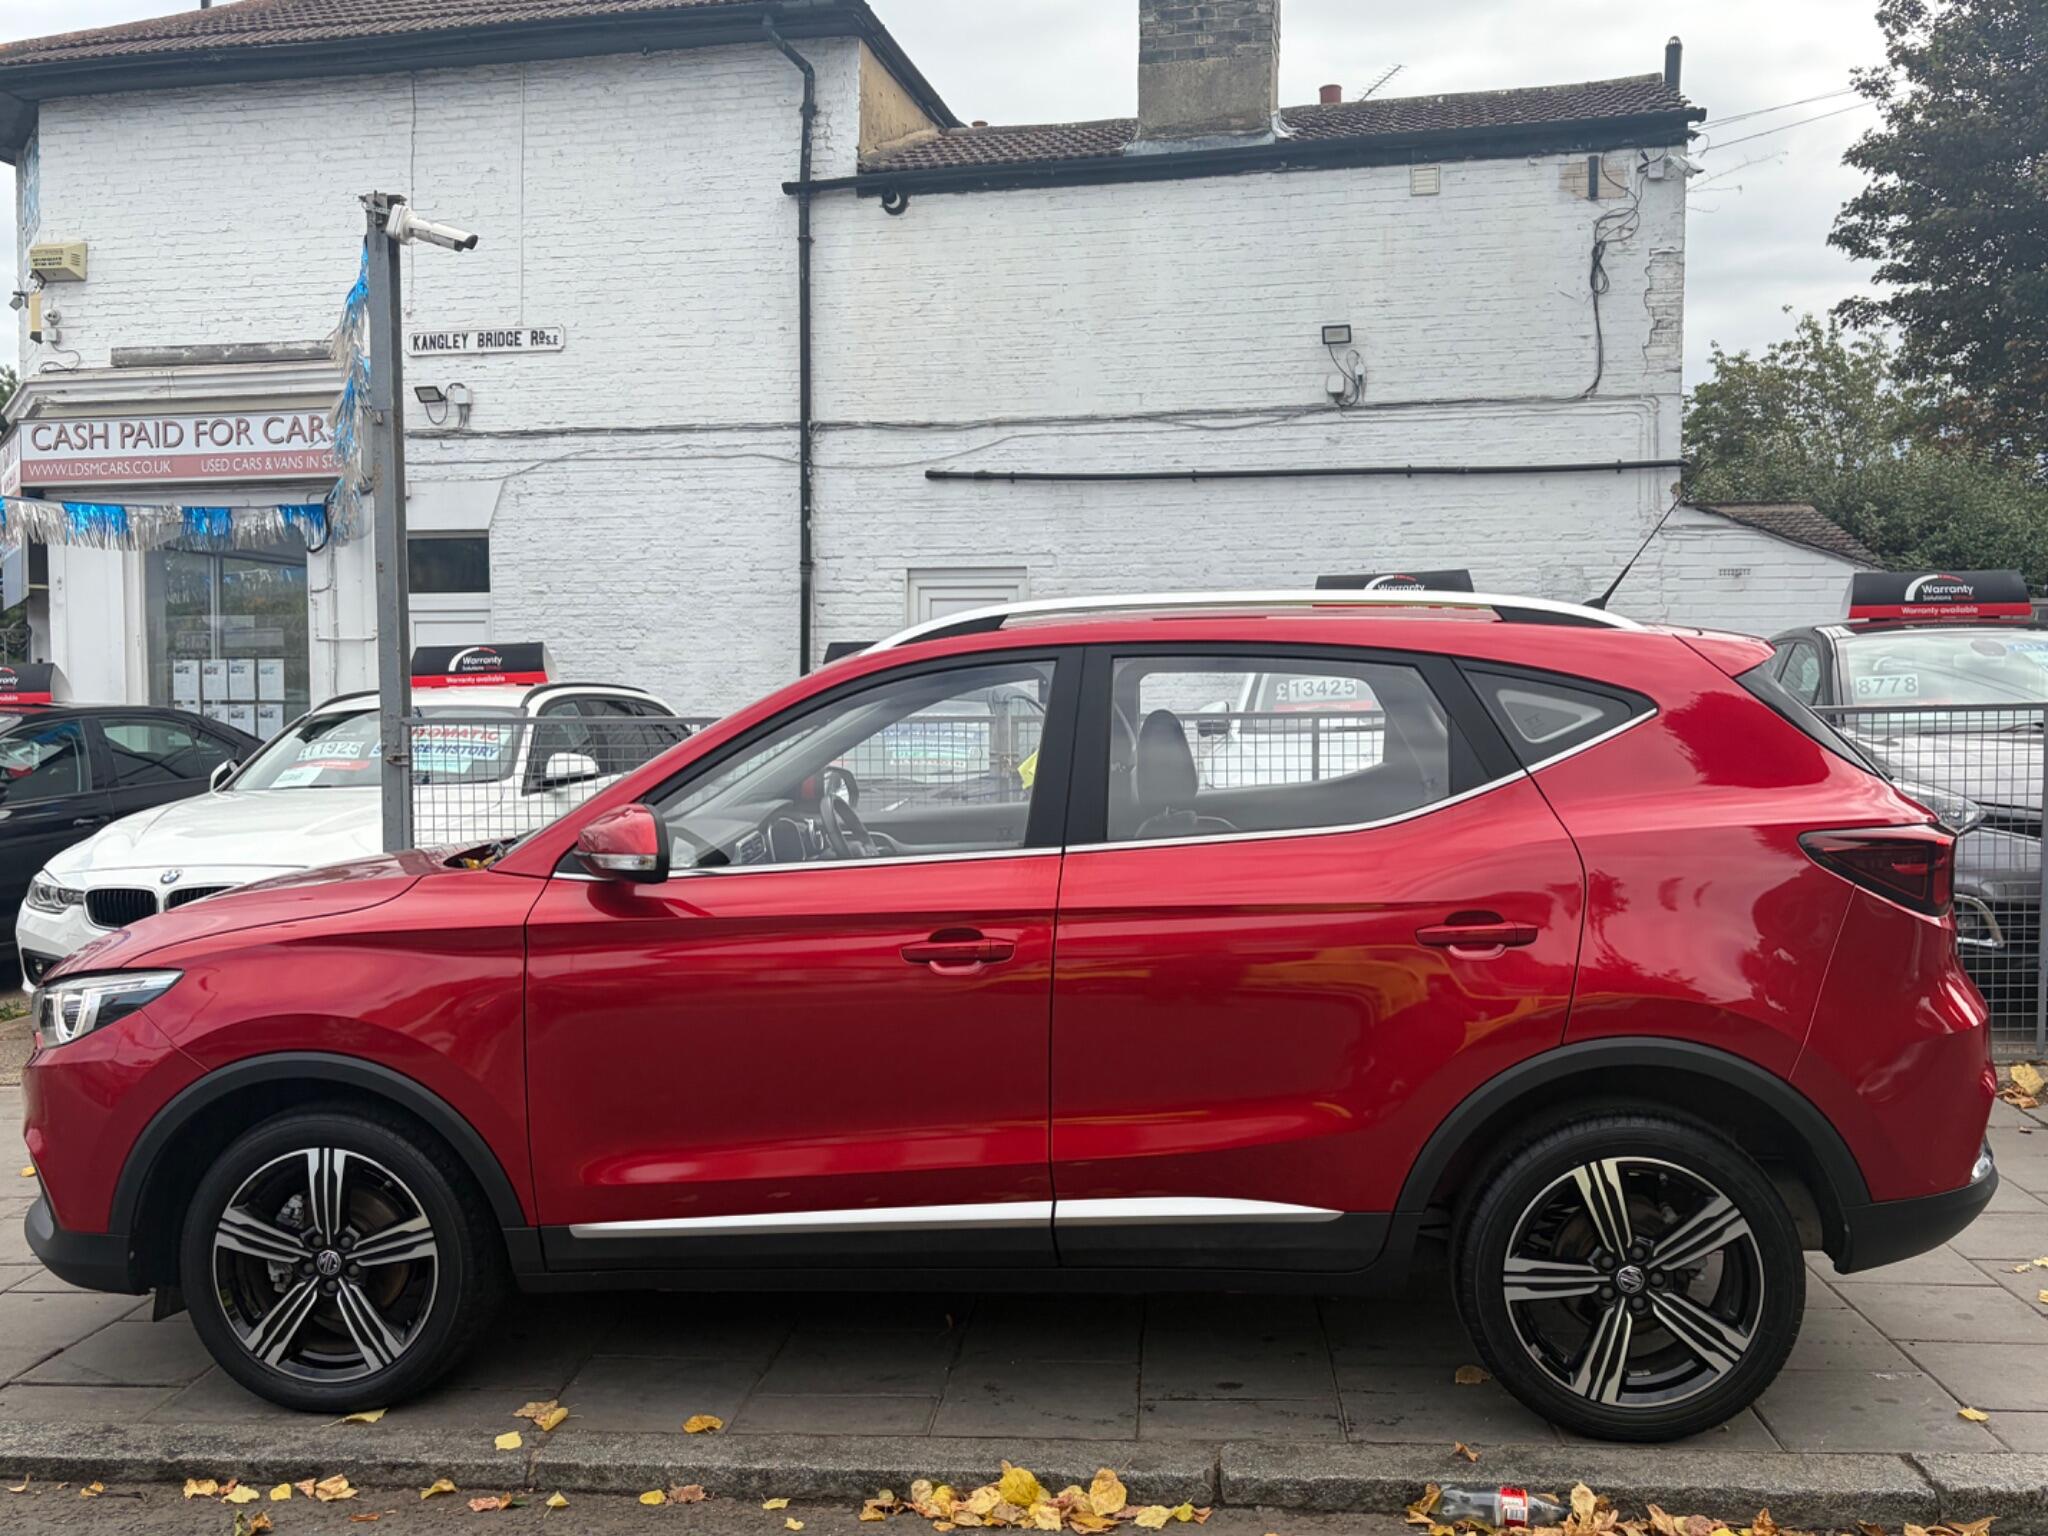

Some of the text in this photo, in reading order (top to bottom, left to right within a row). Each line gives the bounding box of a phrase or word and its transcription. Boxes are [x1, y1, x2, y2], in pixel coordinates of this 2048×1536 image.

[413, 332, 468, 350] KANGLEY
[477, 331, 522, 348] BRIDGE
[31, 422, 109, 450] CASH
[119, 420, 184, 449] PAID
[194, 416, 253, 447] FOR
[28, 460, 172, 476] WWW.LDSMCARS.CO.UK
[201, 458, 230, 472] USED
[233, 457, 262, 471] CARS
[265, 457, 273, 470] &
[274, 455, 303, 469] VANS
[306, 455, 318, 467] IN
[1921, 585, 1974, 595] Warranty
[1901, 605, 1979, 615] Warranty available
[462, 656, 502, 665] Warranty
[1858, 677, 1917, 695] 8778
[435, 744, 497, 757] HISTORY
